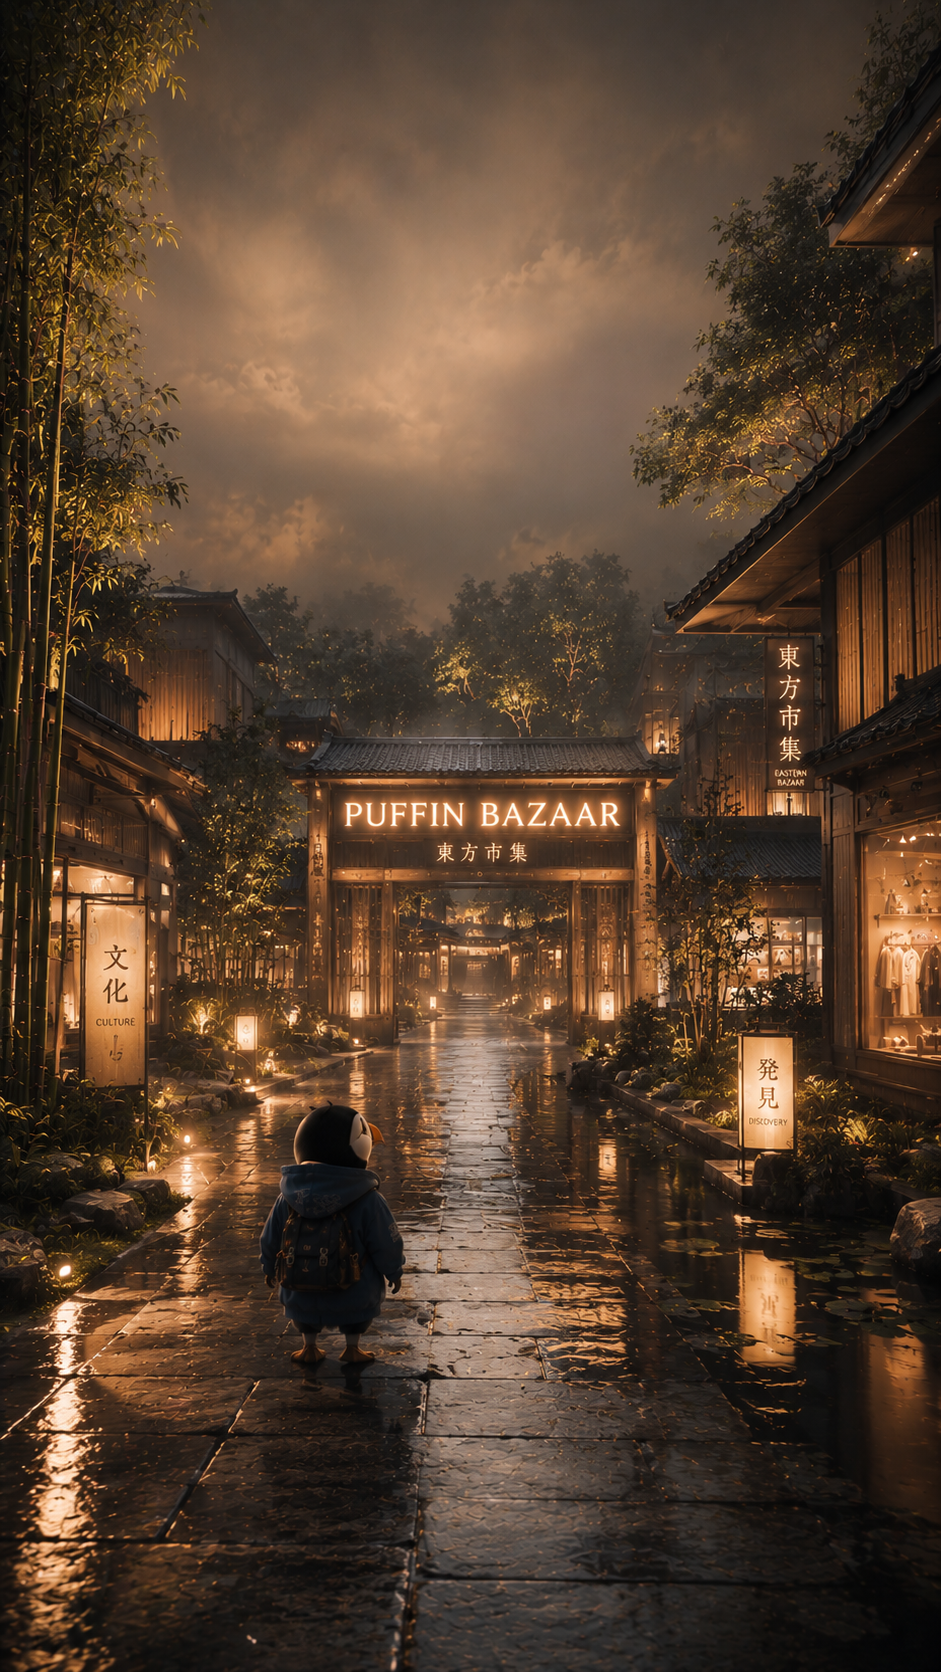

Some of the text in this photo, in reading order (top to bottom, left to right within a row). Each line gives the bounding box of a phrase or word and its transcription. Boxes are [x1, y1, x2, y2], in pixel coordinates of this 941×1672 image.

[778, 644, 802, 762] 東方市集
[344, 802, 620, 827] PUFFIN BAZAAR
[436, 842, 528, 864] 東方市集
[103, 944, 129, 1004] 文化
[95, 1017, 136, 1027] CULTURE
[757, 1058, 779, 1110] 発見
[748, 1117, 788, 1126] DISCOVERY
